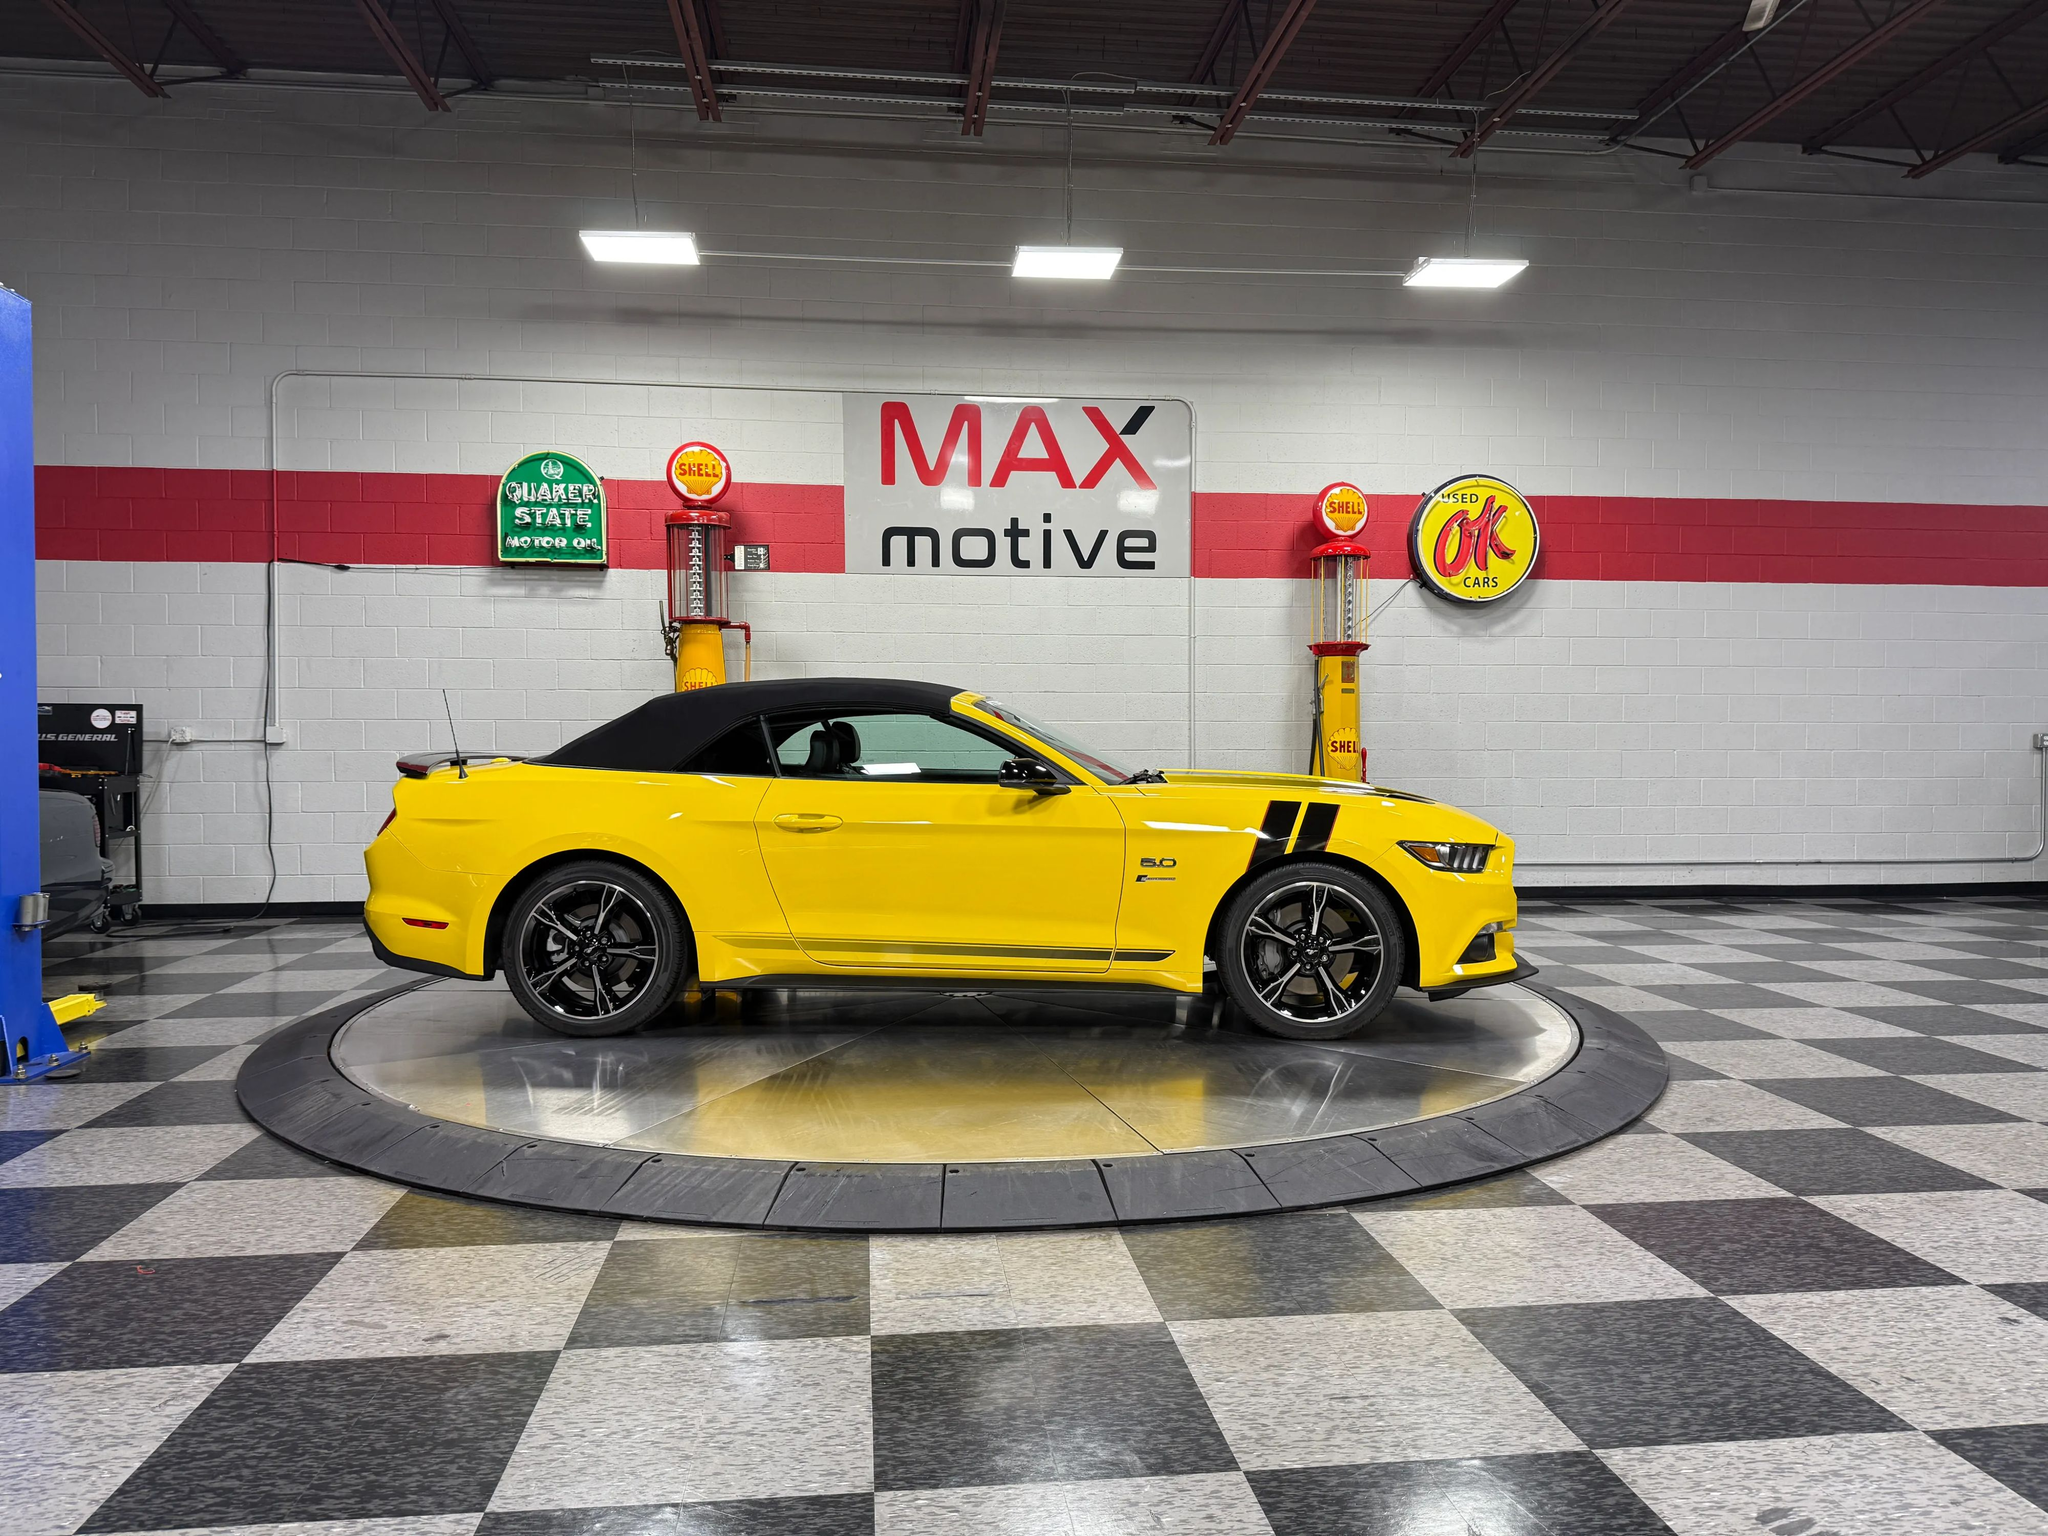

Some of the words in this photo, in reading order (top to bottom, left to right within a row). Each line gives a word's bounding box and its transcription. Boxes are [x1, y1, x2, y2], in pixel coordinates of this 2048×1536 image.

[881, 401, 1157, 489] MAX
[678, 462, 719, 478] SHELL
[506, 482, 599, 504] QUAKER
[1441, 493, 1479, 503] USED
[1329, 501, 1362, 515] SHELL
[515, 506, 592, 528] STATE
[506, 536, 567, 548] MOTOR
[572, 537, 601, 549] OIL
[881, 512, 1157, 570] motive
[1433, 495, 1516, 577] OK
[1463, 577, 1498, 588] CARS
[1330, 740, 1358, 753] SHEL
[1140, 857, 1176, 868] 5.0
